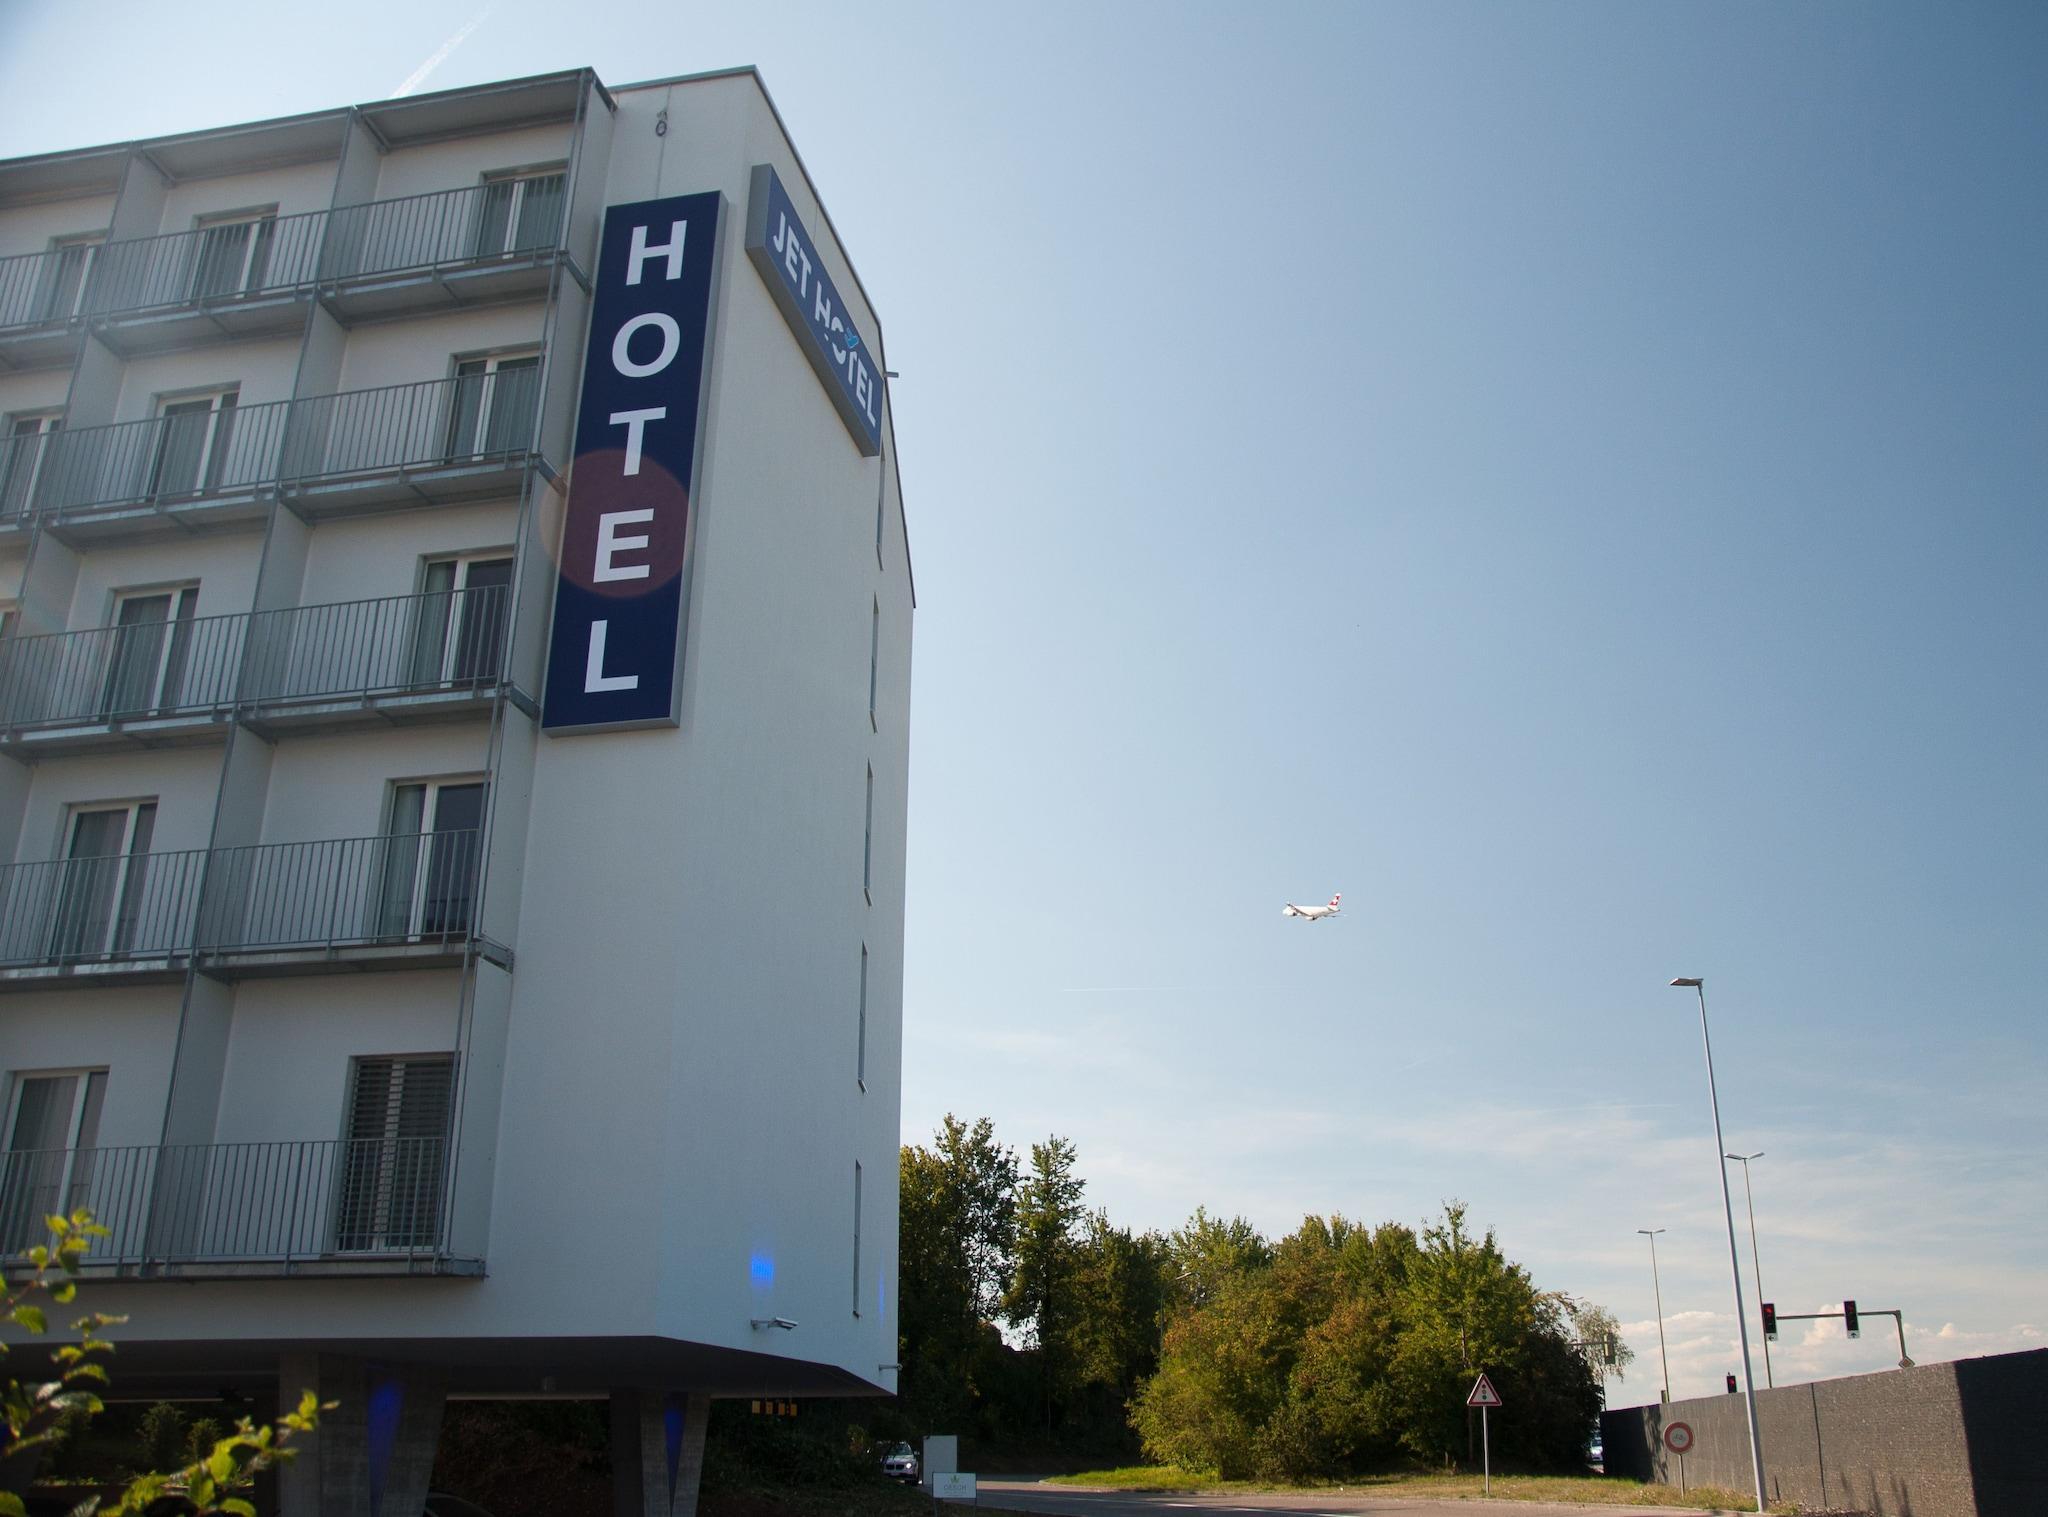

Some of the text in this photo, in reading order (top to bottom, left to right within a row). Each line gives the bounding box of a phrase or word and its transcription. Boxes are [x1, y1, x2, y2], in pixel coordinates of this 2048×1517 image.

[585, 220, 687, 693] HOTEL
[773, 211, 876, 428] JET HOTEL
